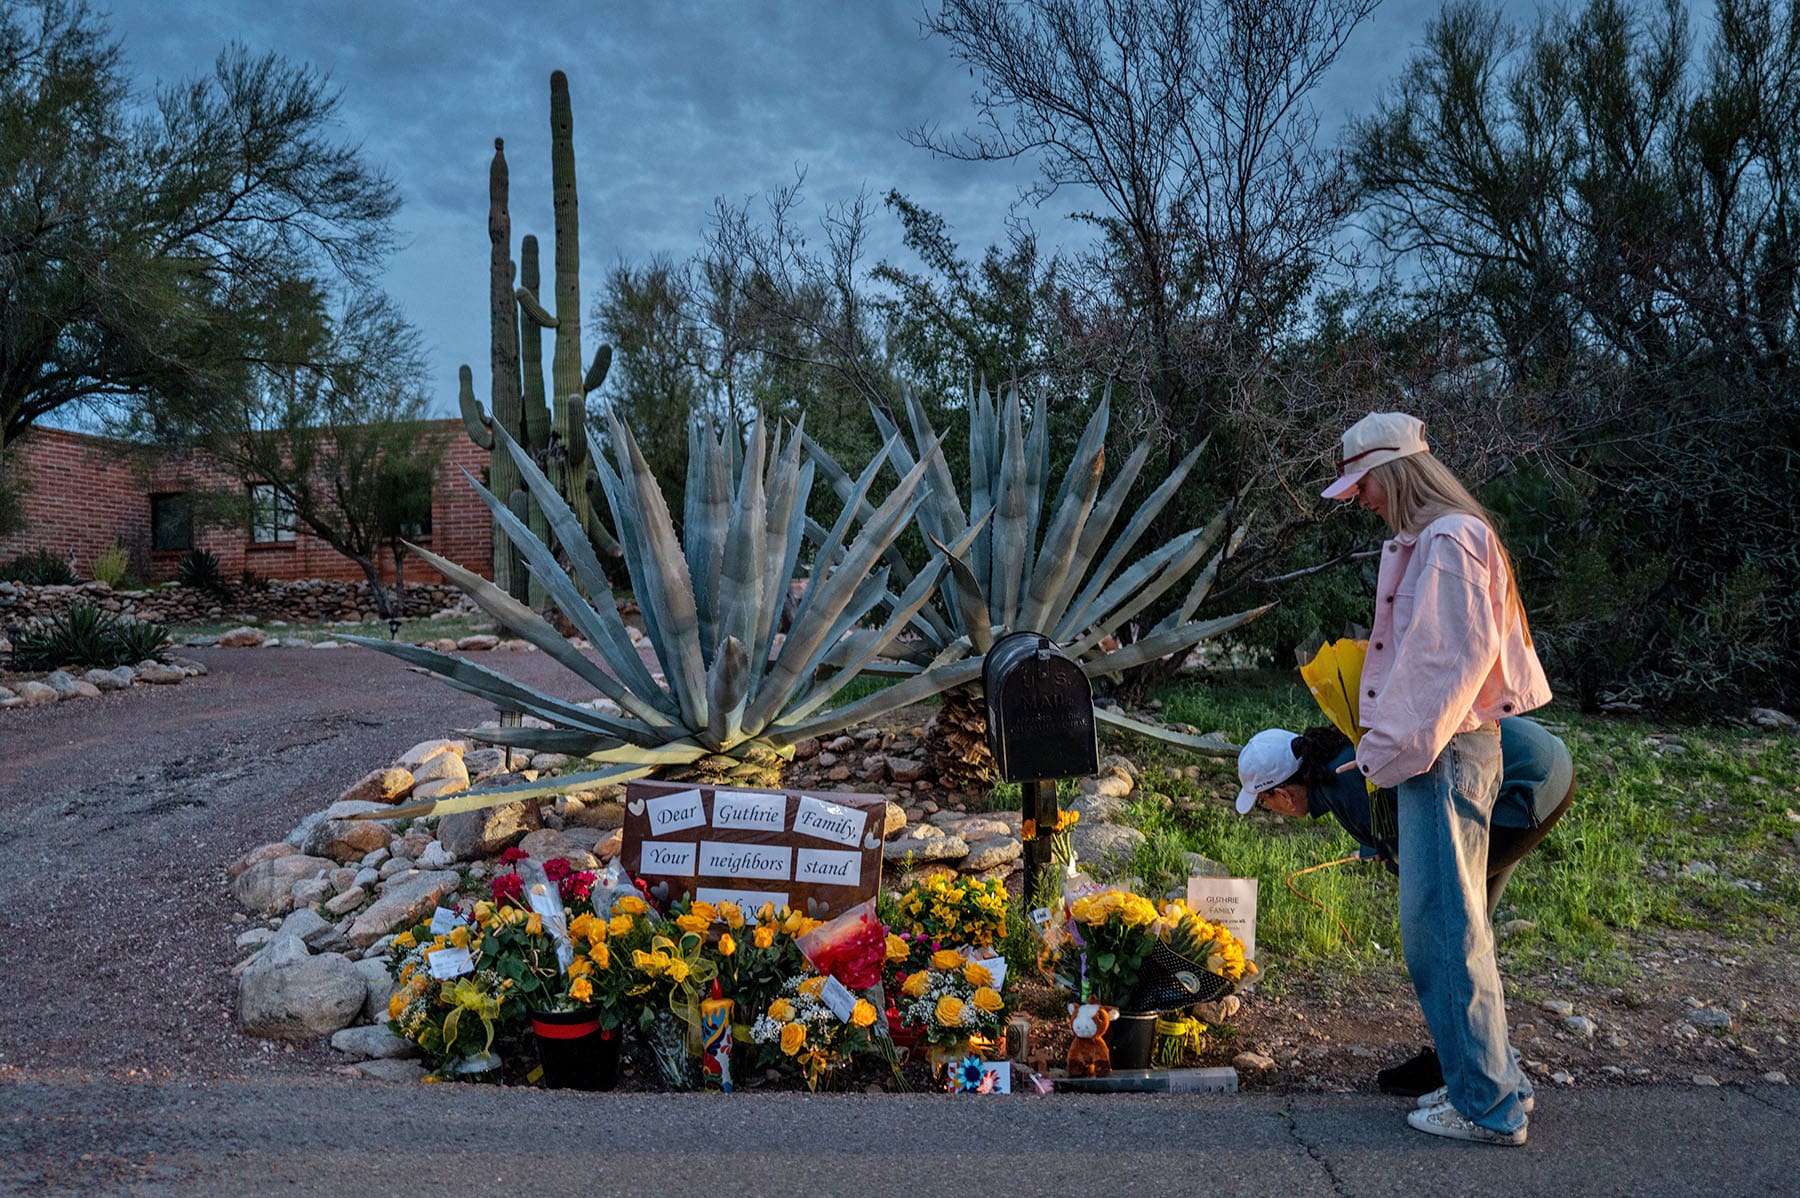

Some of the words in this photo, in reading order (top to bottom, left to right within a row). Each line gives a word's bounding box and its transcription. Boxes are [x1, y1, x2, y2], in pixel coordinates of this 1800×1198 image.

[657, 804, 697, 825] Dear
[719, 803, 779, 824] Guthrie
[801, 809, 857, 841] Family,
[650, 847, 690, 866] Your
[709, 852, 783, 874] neighbors
[803, 858, 852, 877] stand
[1206, 896, 1239, 904] GUTHRIE
